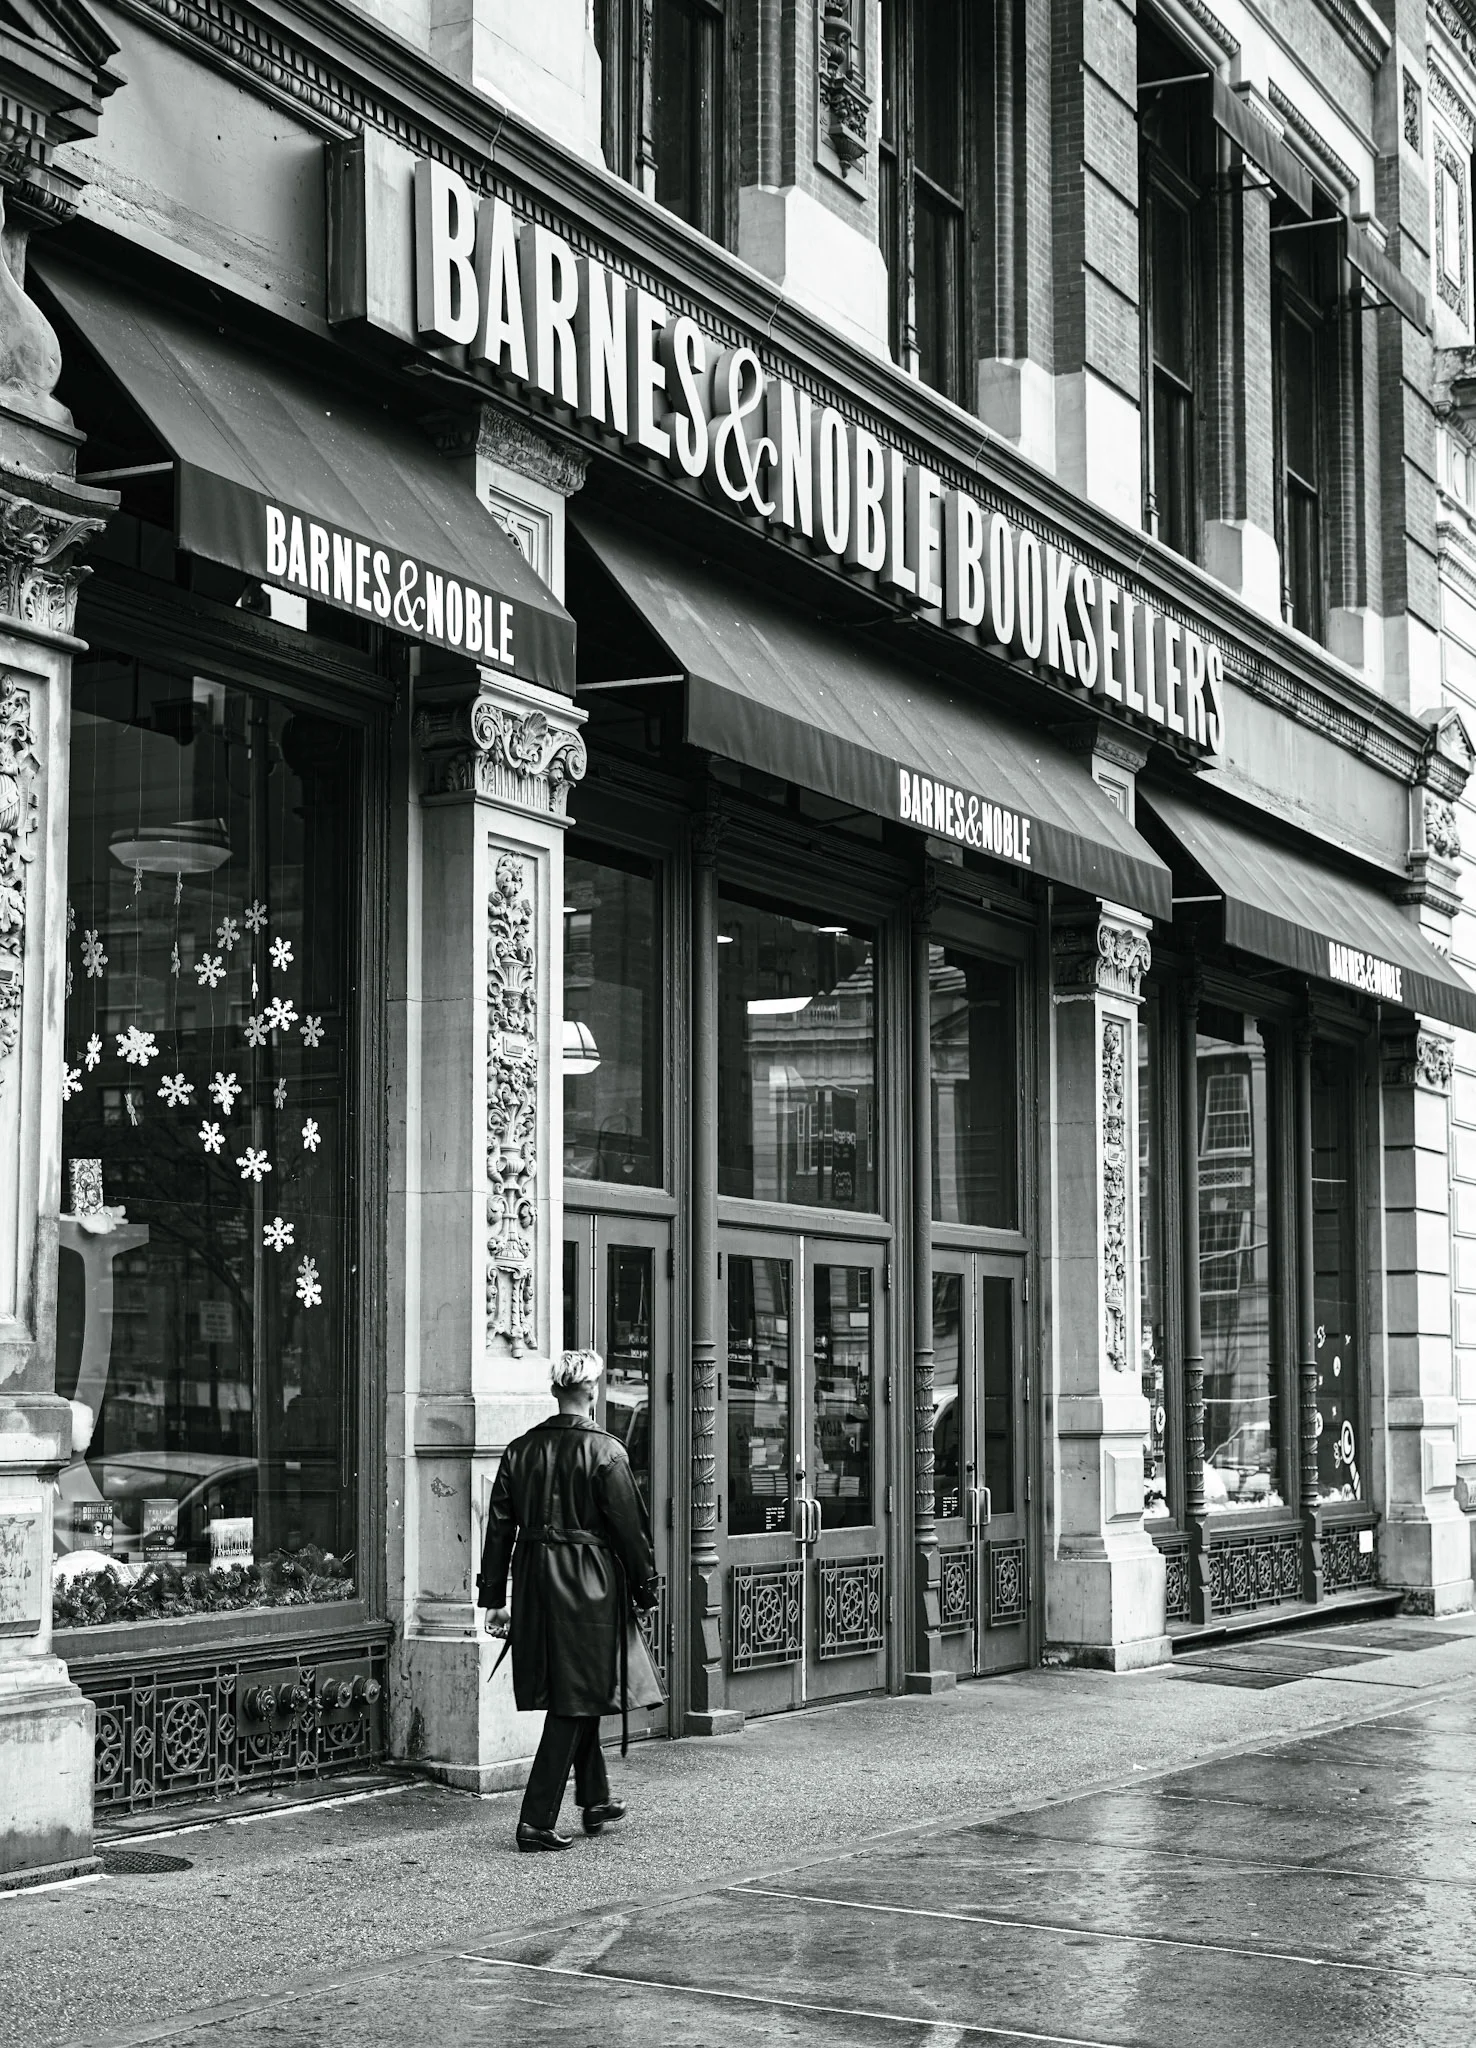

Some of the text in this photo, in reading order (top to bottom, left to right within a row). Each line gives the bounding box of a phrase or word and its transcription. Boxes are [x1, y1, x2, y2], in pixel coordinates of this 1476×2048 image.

[415, 158, 1225, 756] BARNES&NOBLE BOOKSELLERS
[265, 504, 516, 667] BARNES&NOBLE
[898, 768, 1032, 865] BARNES&NOBLE
[82, 1506, 113, 1514] DOUGLAS
[82, 1513, 113, 1521] PRESTON
[217, 1547, 252, 1557] Penitence
